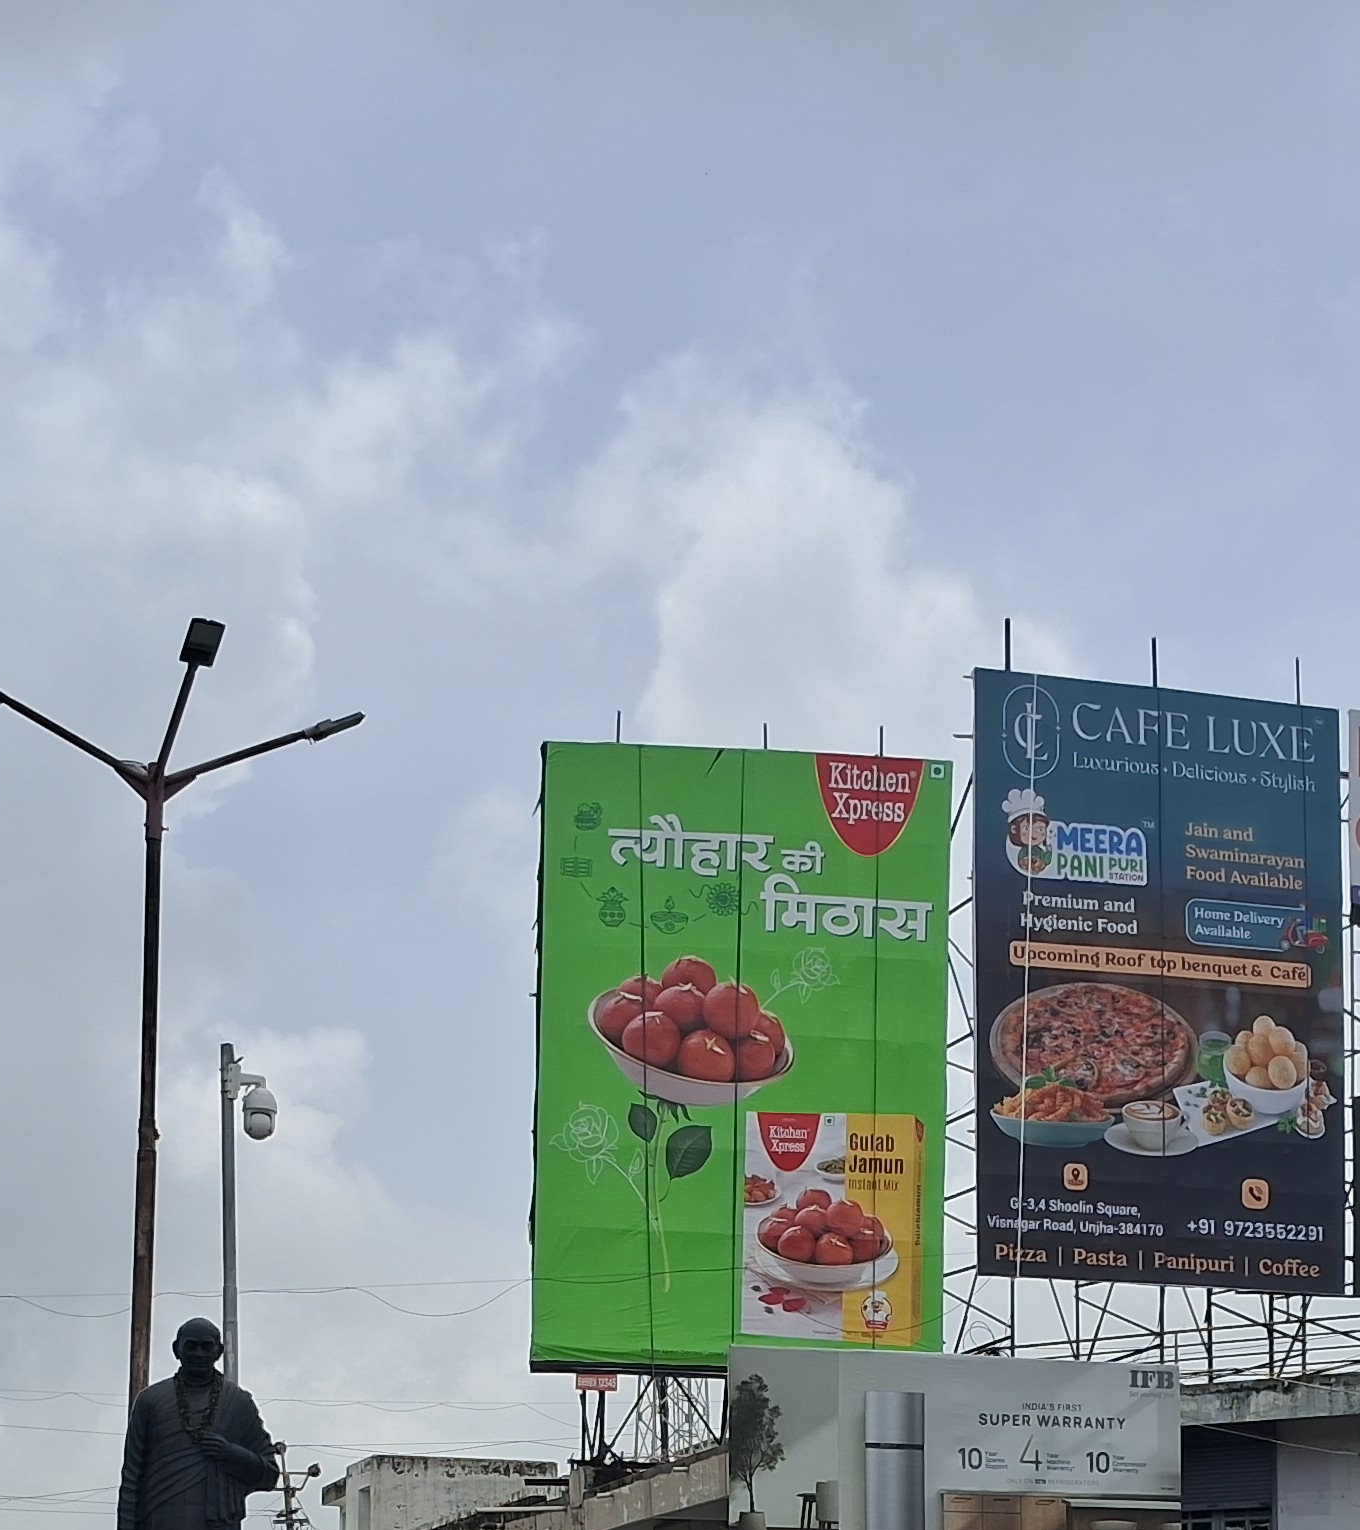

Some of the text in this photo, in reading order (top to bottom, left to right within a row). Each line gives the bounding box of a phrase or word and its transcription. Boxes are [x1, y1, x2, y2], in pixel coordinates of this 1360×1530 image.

[1071, 701, 1316, 763] CAFE LUXE
[828, 761, 911, 793] Kitchen
[1072, 751, 1316, 793] Luxurious Delicious Stylish
[831, 792, 905, 824] Xpress
[1056, 825, 1142, 857] MEERA
[1185, 822, 1254, 842] Jain and
[608, 814, 825, 876] त्यौहार की
[1056, 854, 1143, 881] PANI PURI
[1185, 844, 1305, 870] Swaminarayan
[1108, 872, 1144, 883] STATION
[1186, 866, 1304, 891] Food Available
[760, 873, 934, 942] मिठास
[1022, 891, 1136, 914] Premium and
[1019, 912, 1138, 936] Hygienic Food
[1193, 906, 1285, 929] Home Delivery
[1194, 923, 1252, 941] Available
[1013, 945, 1308, 982] Upcoming Roof top benquet & Café
[770, 1139, 806, 1155] Xpress
[849, 1132, 895, 1153] Gulab
[848, 1154, 904, 1175] Jamun
[1049, 1198, 1141, 1219] Shoolin Square,
[987, 1215, 1164, 1238] Visnagar Road, Unjha-384170
[1186, 1218, 1325, 1243] +91 9723552291
[994, 1243, 1321, 1279] Pizza Pasta Panipuri Coffee
[1129, 1369, 1175, 1389] IFB
[1022, 1402, 1082, 1412] INDIA'S FIRST
[979, 1413, 1126, 1430] SUPER WARRANTY
[958, 1447, 982, 1470] 10
[1019, 1434, 1042, 1472] 4
[1086, 1451, 1110, 1474] 10
